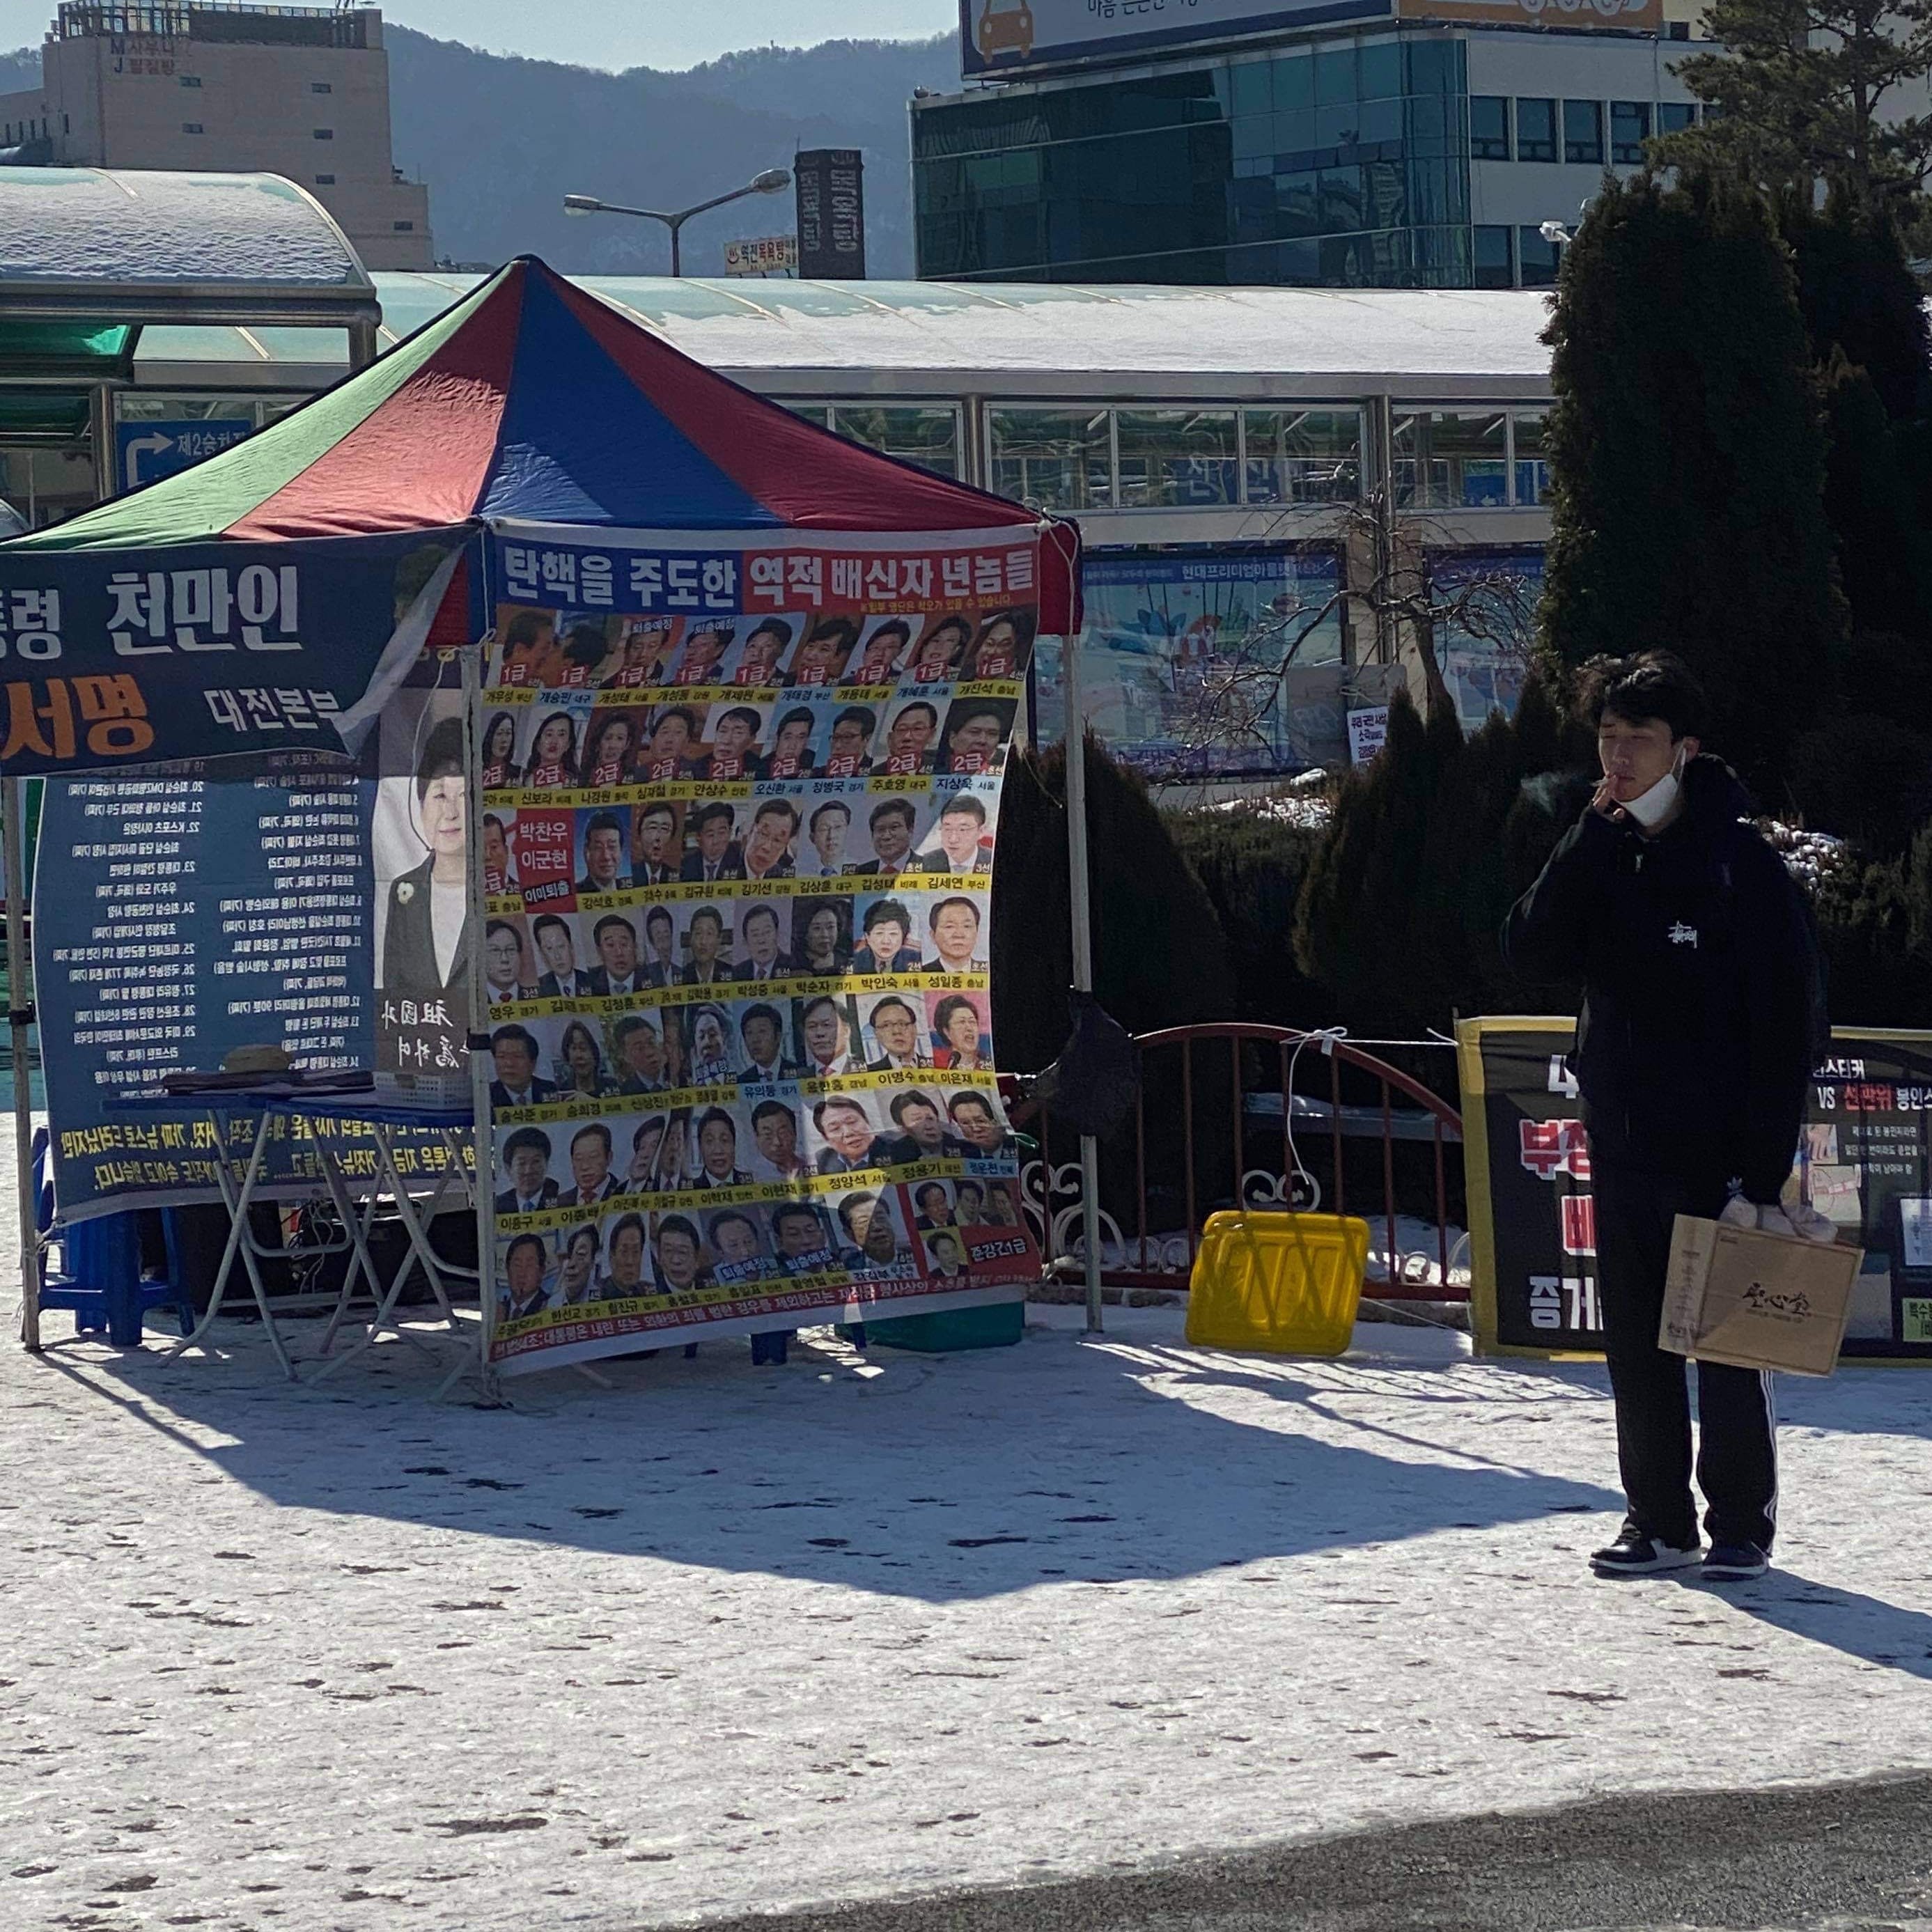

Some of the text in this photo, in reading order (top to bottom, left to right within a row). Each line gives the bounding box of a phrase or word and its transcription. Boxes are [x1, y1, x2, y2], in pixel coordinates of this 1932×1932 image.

[111, 39, 124, 54] M
[114, 57, 123, 72] J
[505, 546, 1034, 609] 탄핵을 주도한 역적 배신자 년놈들
[0, 564, 304, 660] 령 천만인
[0, 673, 341, 761] 서명 대전본부
[536, 763, 560, 785] 2급
[594, 764, 619, 785] 2급
[651, 758, 676, 779] 2급
[712, 758, 741, 778] 2급
[772, 759, 797, 778] 2급
[829, 756, 857, 774] 2급
[889, 754, 915, 773] 2급
[954, 751, 983, 771] 2급
[694, 784, 728, 796] 안상수
[872, 779, 906, 790] 주호영
[520, 821, 568, 842] 박찬우
[522, 850, 568, 871] 이군현
[927, 877, 963, 889] 김세연
[860, 976, 898, 990] 박인숙
[928, 976, 963, 988] 성일종
[878, 1073, 914, 1086] 이명수
[940, 1073, 973, 1085] 이은재
[1817, 1086, 1836, 1109] VS
[1844, 1084, 1892, 1111] 선관위
[829, 1174, 866, 1190] 정양석
[1529, 1275, 1604, 1331] 증거
